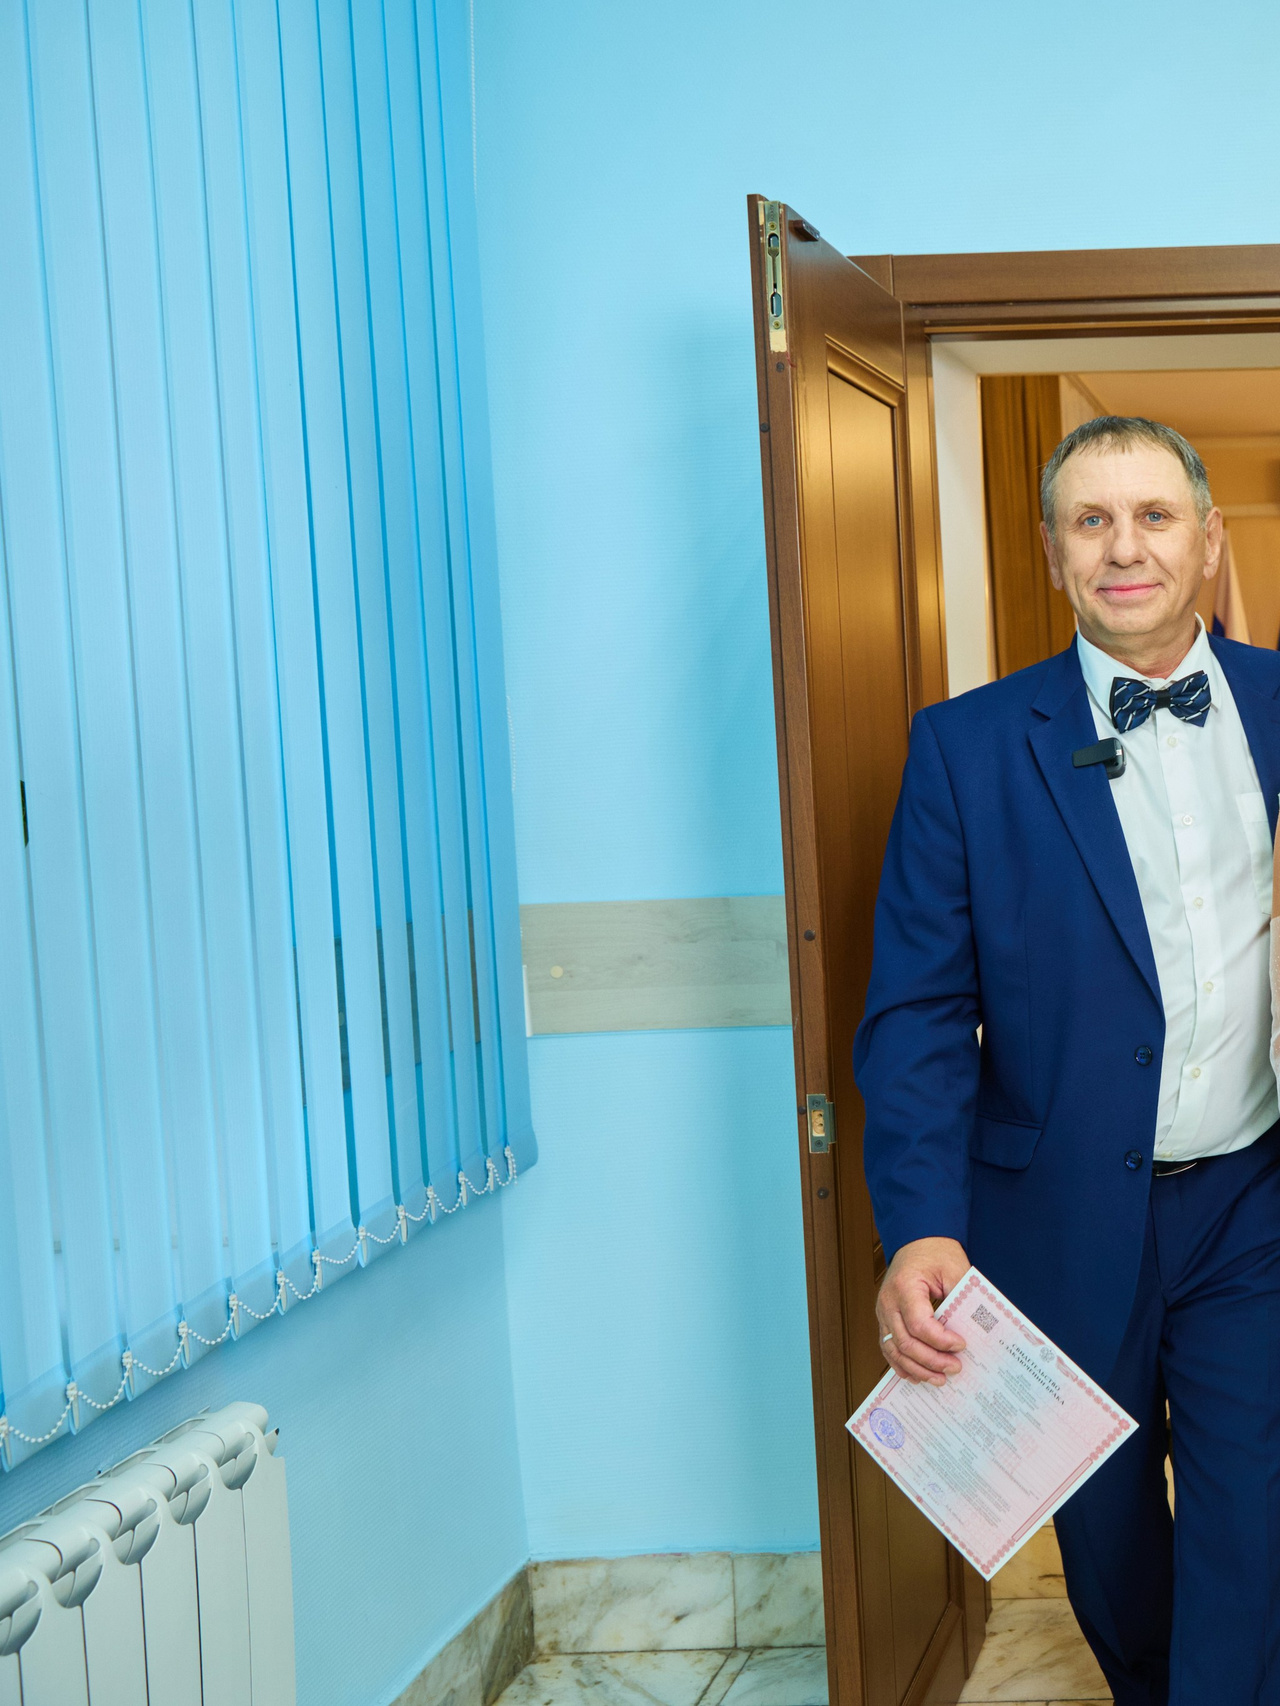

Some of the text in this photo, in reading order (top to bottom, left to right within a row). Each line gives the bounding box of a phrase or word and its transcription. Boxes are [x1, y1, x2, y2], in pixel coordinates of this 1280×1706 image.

[1006, 1345, 1046, 1387] ЗАКЛЮЧЕНИИ
[1045, 1385, 1065, 1406] БРАКА
[1011, 1343, 1061, 1392] СВИДЕТЕЛЬСТВО
